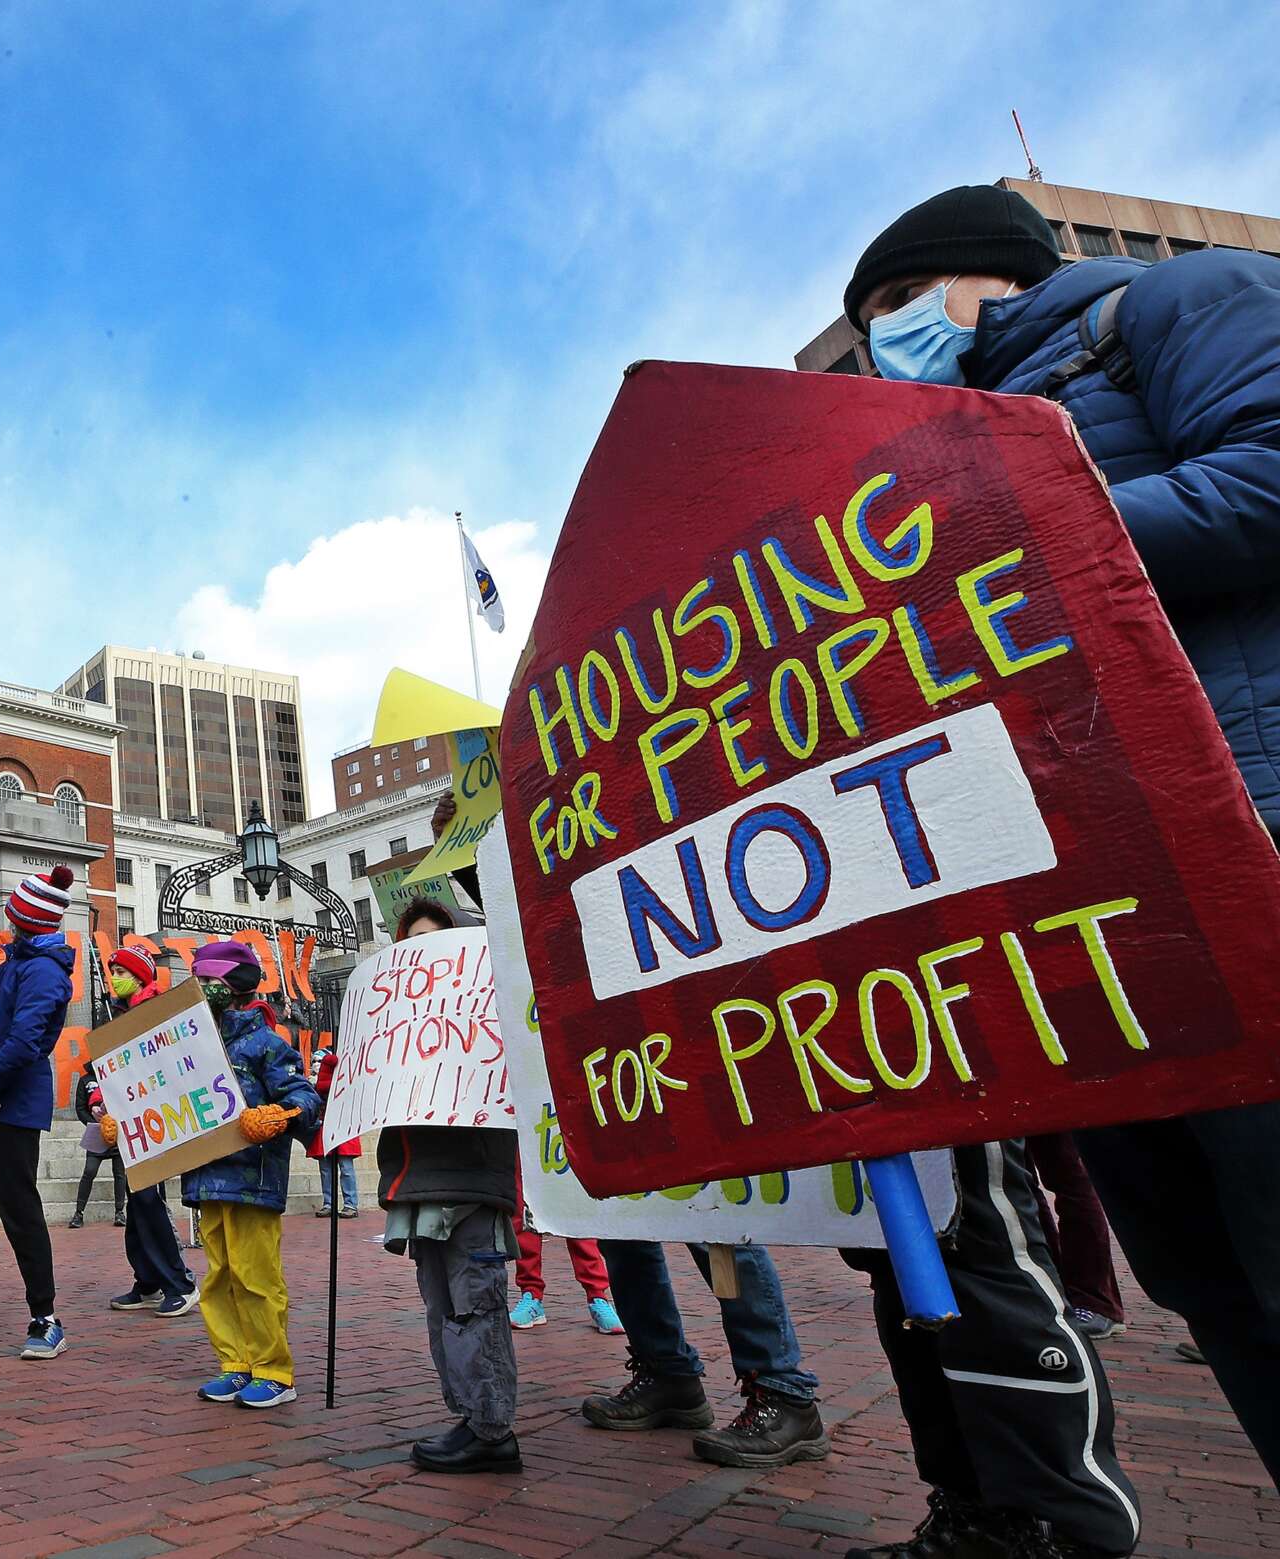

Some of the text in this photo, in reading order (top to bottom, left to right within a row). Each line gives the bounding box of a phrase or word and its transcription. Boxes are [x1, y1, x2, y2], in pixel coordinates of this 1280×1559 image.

[528, 473, 933, 777] HOUSING
[528, 549, 1075, 875] FOR PEOPLE
[617, 733, 951, 975] NOT
[310, 926, 344, 943] HOUSE
[583, 897, 1150, 1127] FOR PROFIT
[97, 1049, 131, 1080] KEEP
[138, 1018, 199, 1058] FAMILIES
[121, 1073, 237, 1160] HOMES
[126, 1055, 195, 1101] SAFE IN
